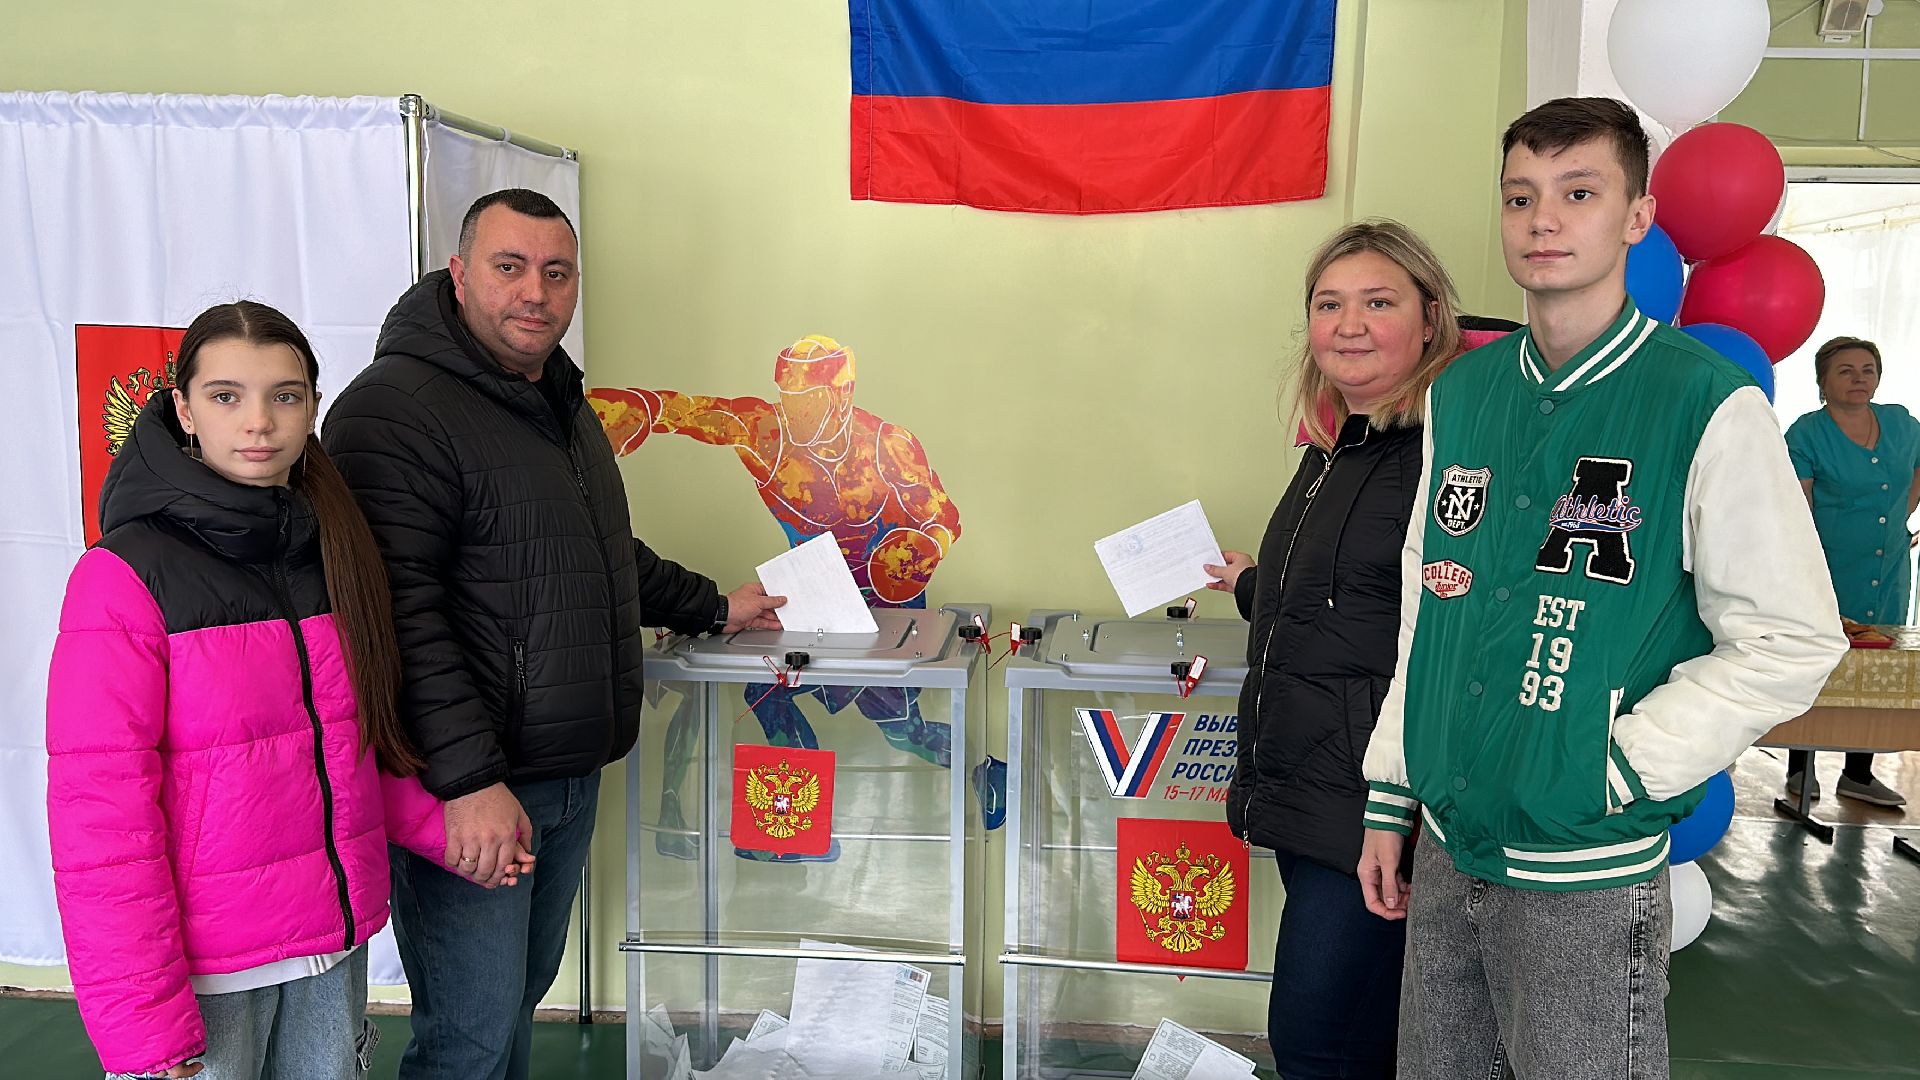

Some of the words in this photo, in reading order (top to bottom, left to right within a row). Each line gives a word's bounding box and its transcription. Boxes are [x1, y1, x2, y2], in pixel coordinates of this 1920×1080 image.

[1451, 474, 1483, 484] ATHLETIC
[1535, 456, 1635, 585] A
[1550, 494, 1642, 523] Athletic
[1447, 519, 1466, 530] DEPT.
[1424, 565, 1472, 589] COLLEGE
[1533, 595, 1585, 631] EST
[1526, 632, 1573, 673] 19
[1519, 670, 1565, 711] 93
[1182, 738, 1238, 758] ПРЕЗ
